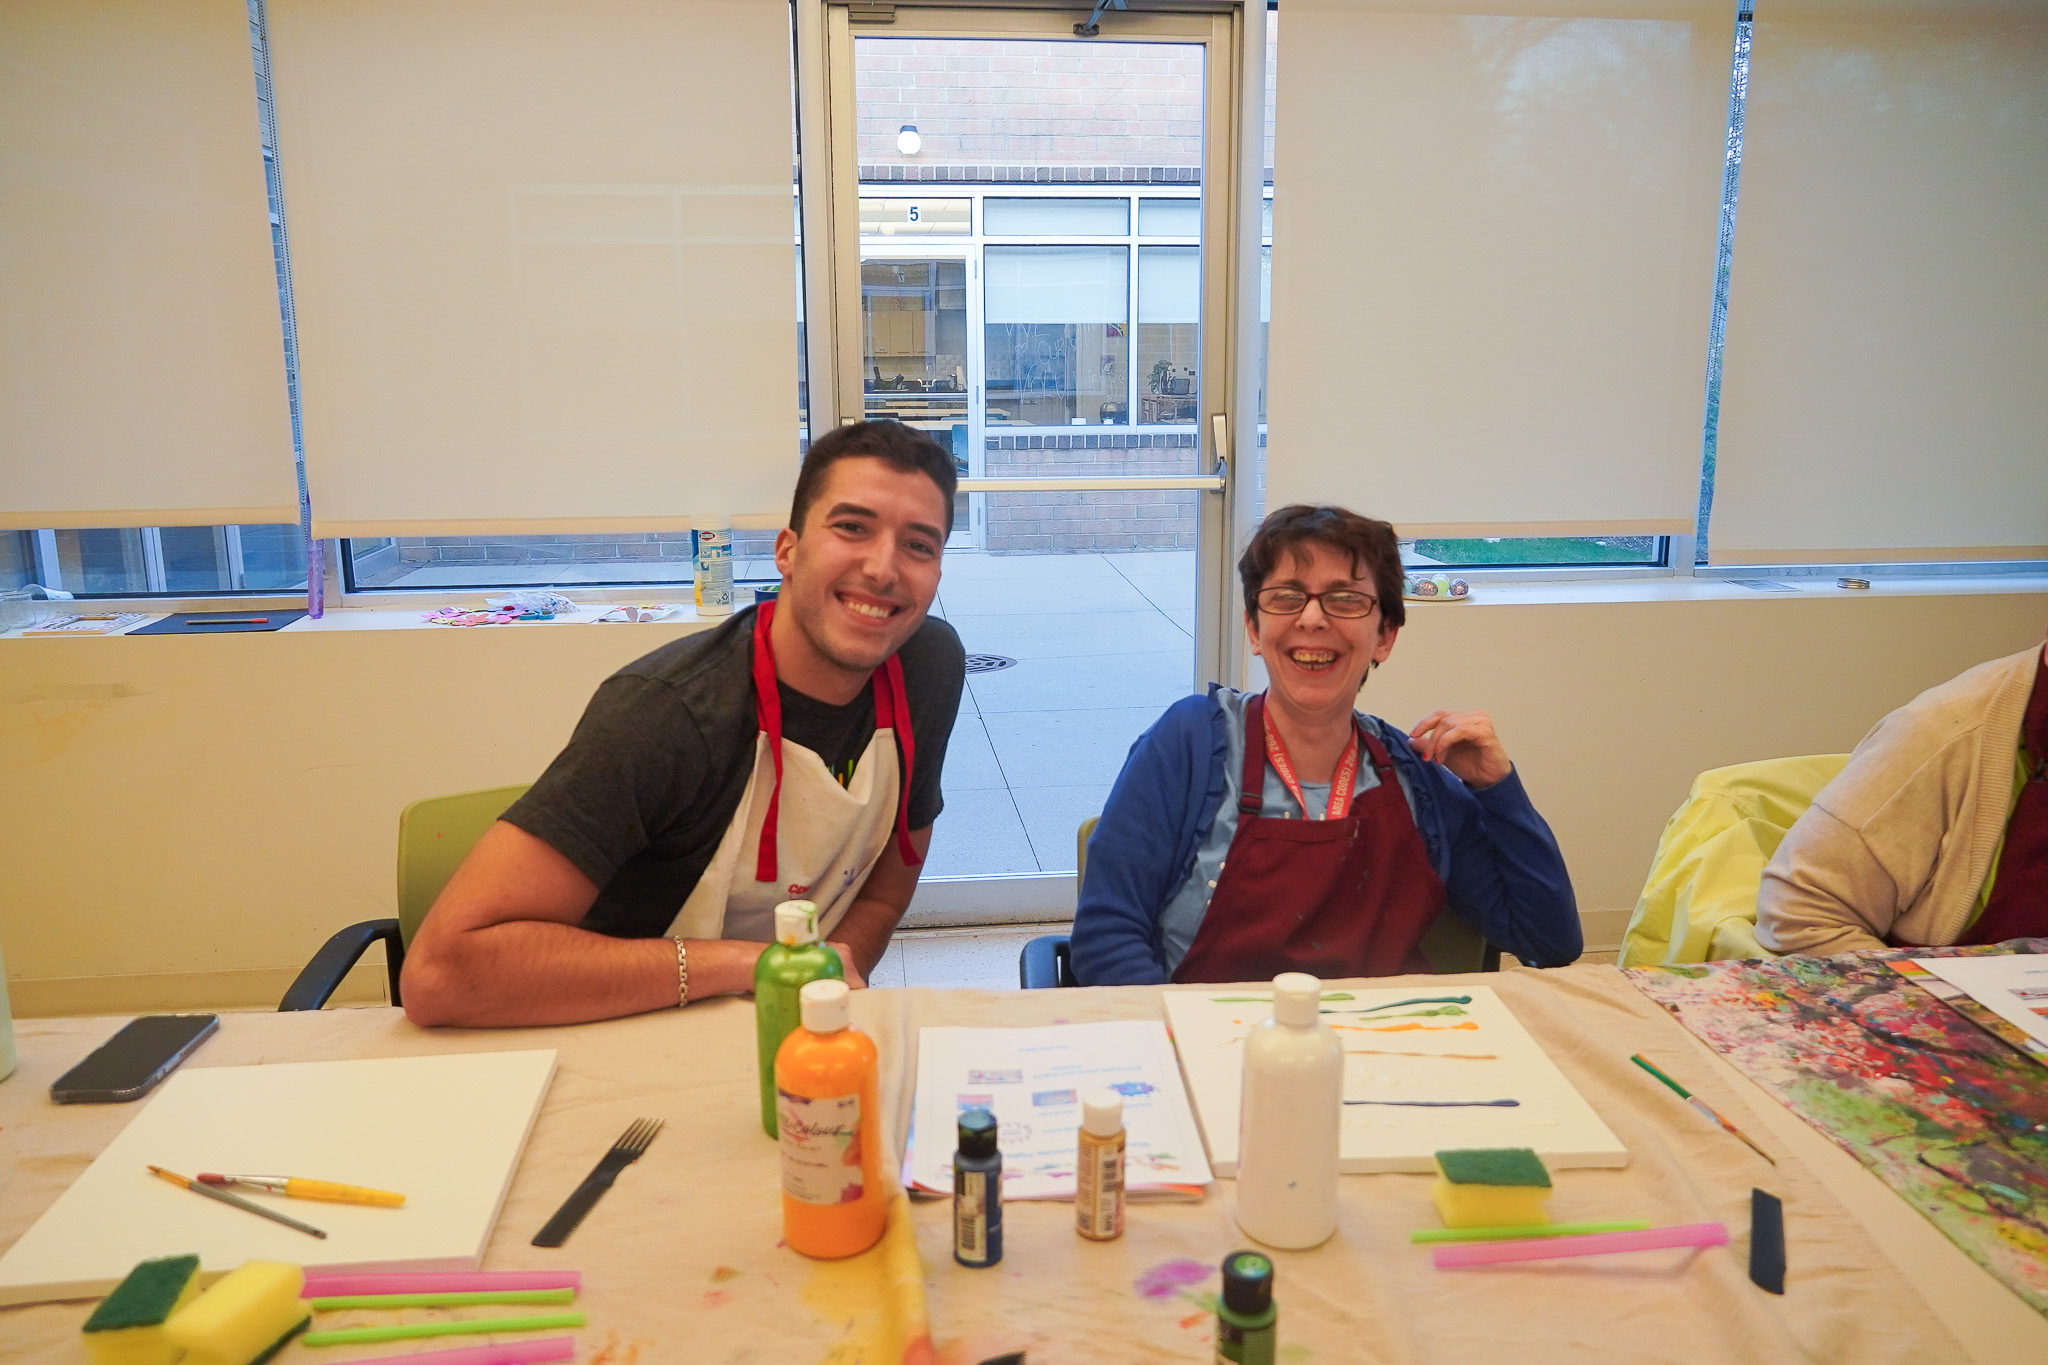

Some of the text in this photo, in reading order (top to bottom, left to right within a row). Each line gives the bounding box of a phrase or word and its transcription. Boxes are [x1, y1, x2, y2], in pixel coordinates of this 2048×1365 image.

[909, 206, 919, 222] 5
[1336, 766, 1354, 796] CODES)
[1331, 797, 1344, 816] AREA
